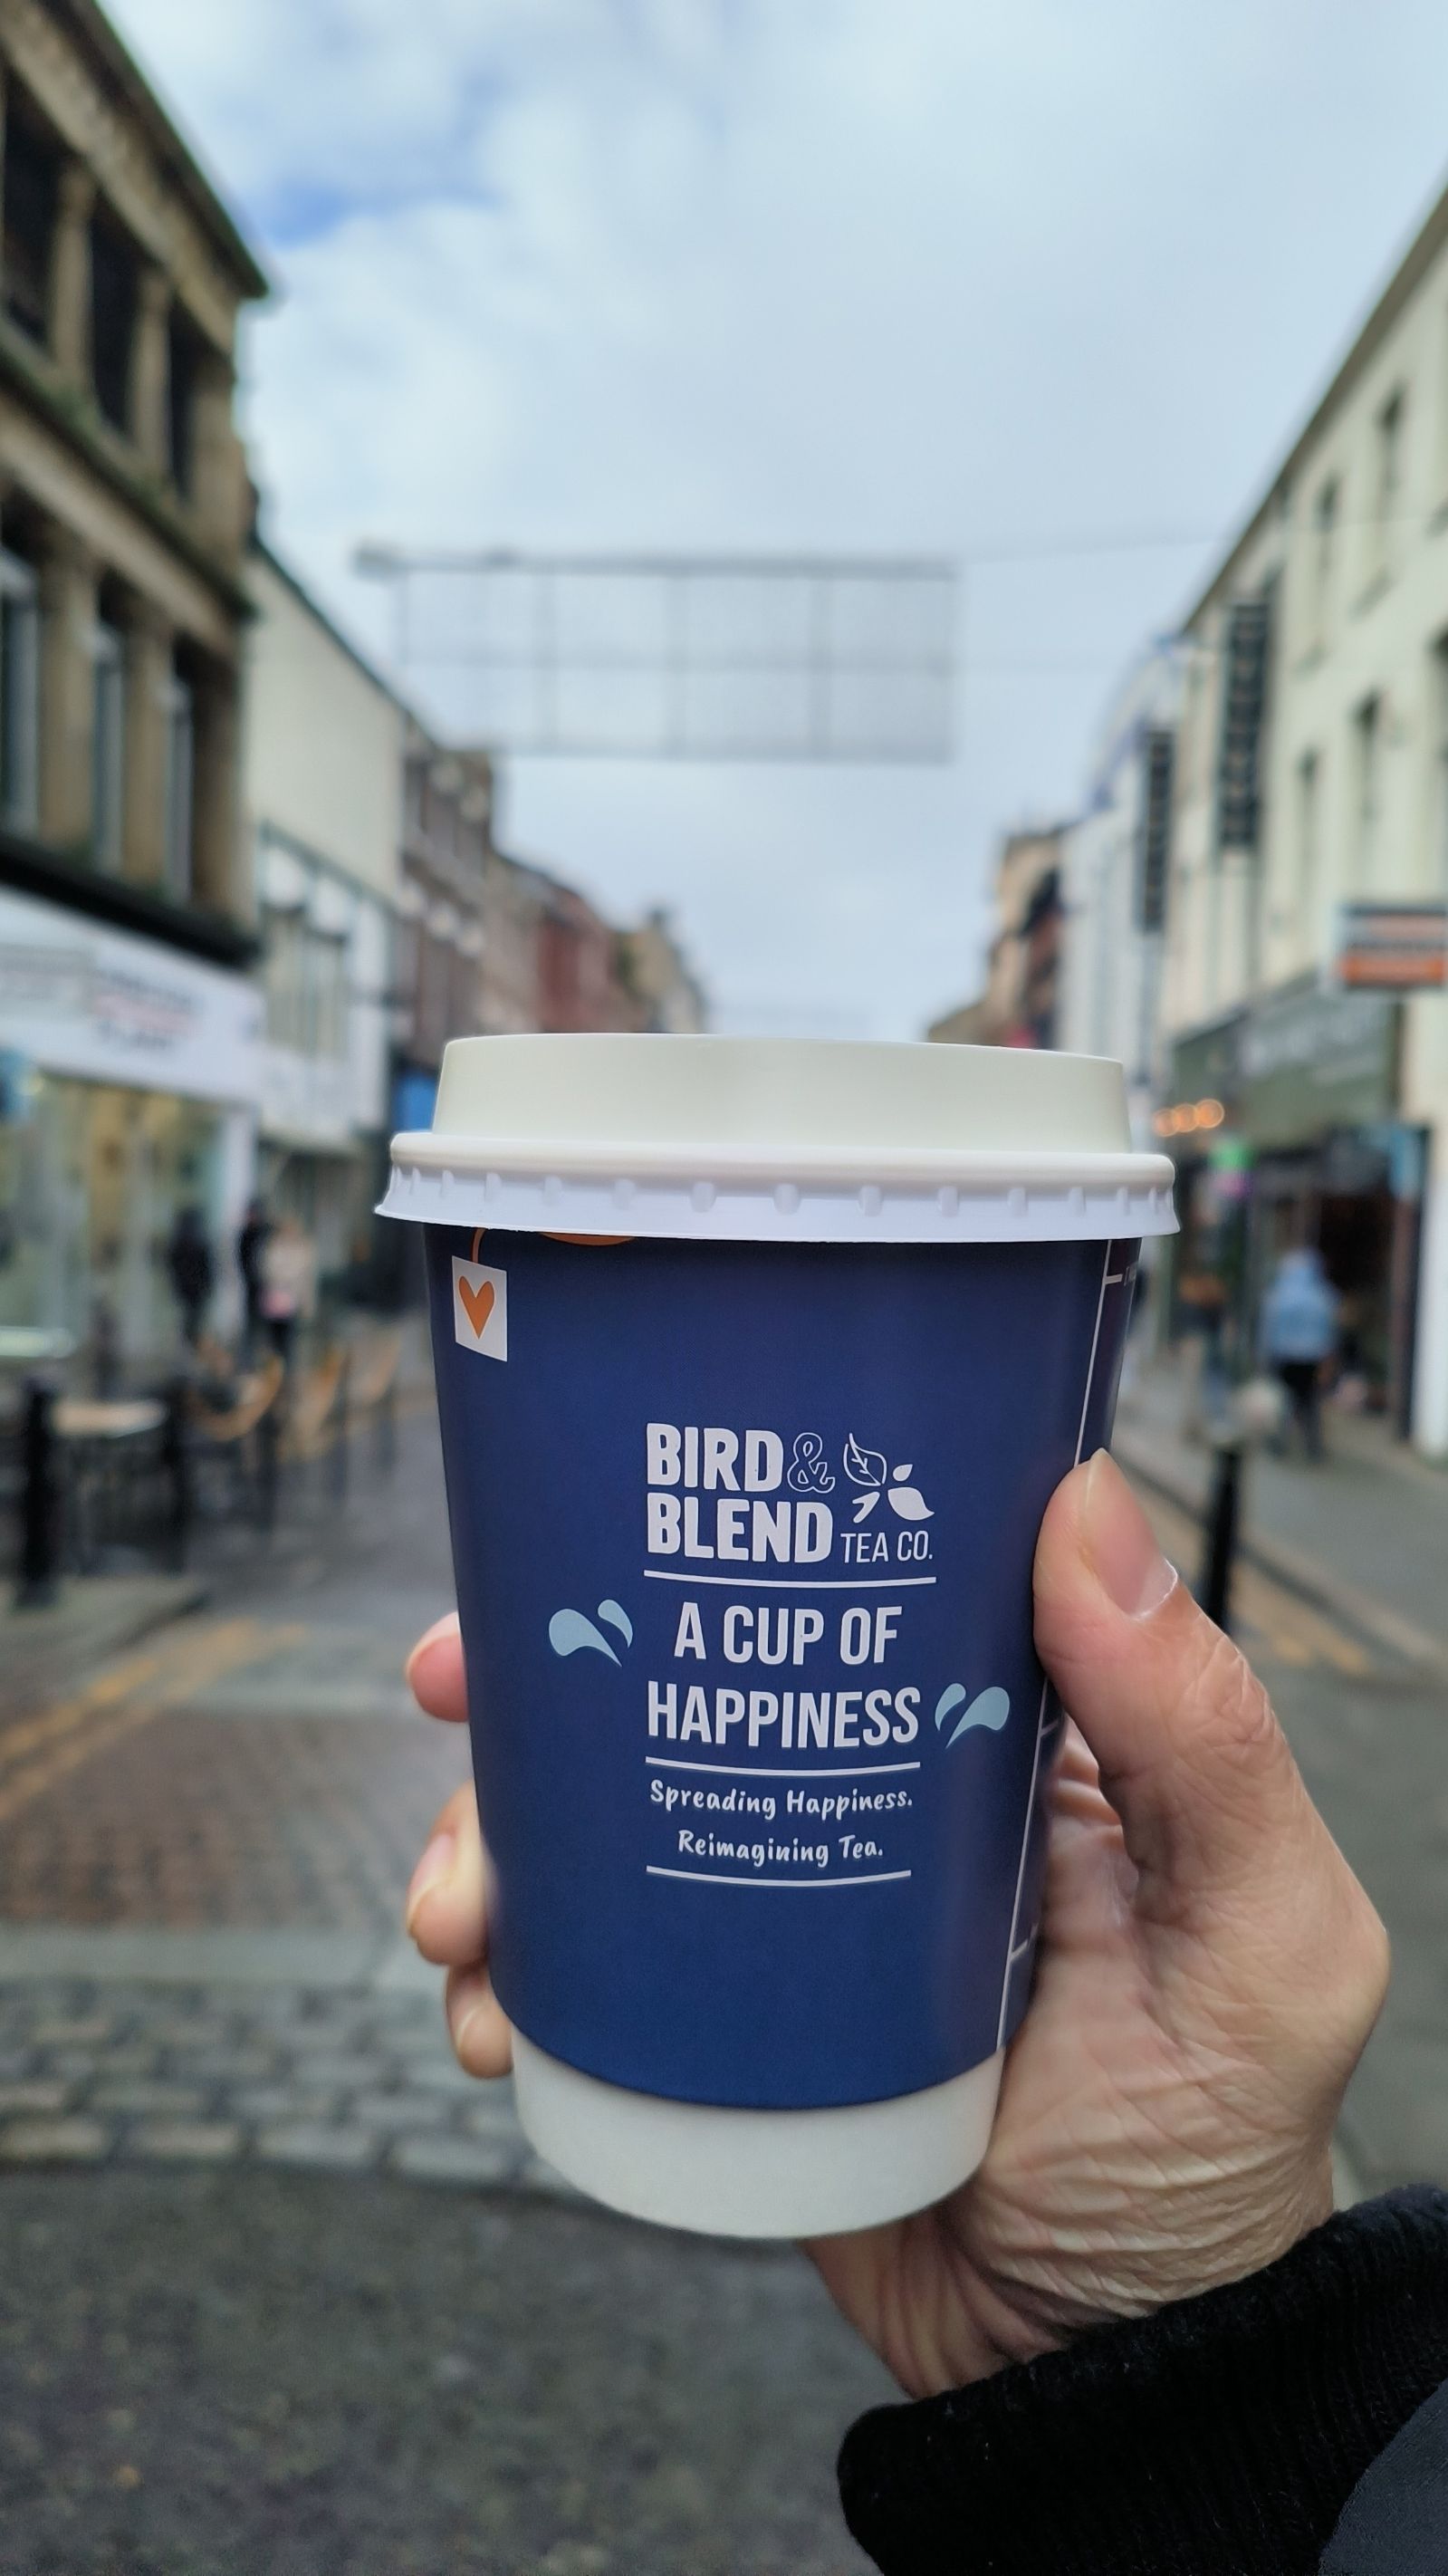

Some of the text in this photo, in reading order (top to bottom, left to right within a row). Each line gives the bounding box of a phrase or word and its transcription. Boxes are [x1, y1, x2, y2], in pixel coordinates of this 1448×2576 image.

[647, 1492, 934, 1563] BLEND TEA CO.
[674, 1600, 903, 1666] A CUP OF
[647, 1680, 921, 1749] HAPPINESS
[650, 1779, 913, 1821] Spreading Happiness.
[678, 1829, 884, 1869] Reimagining Tea.
